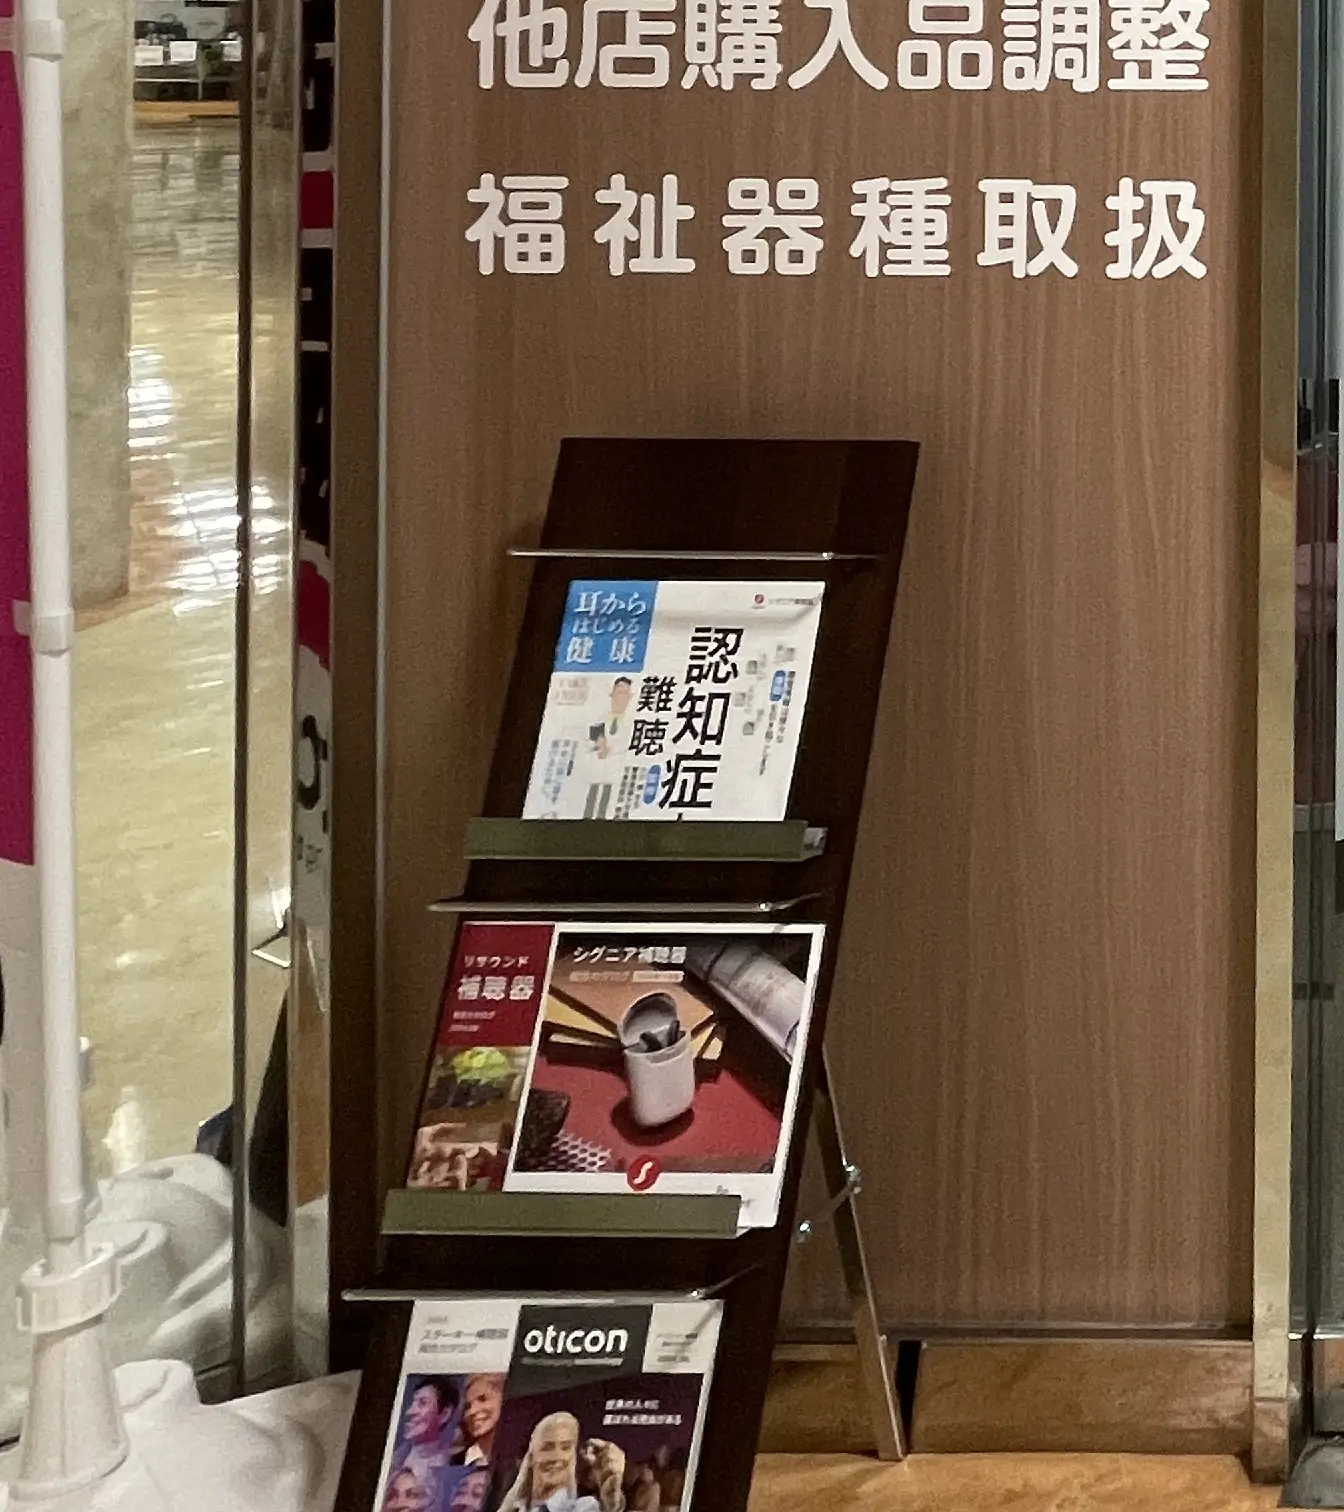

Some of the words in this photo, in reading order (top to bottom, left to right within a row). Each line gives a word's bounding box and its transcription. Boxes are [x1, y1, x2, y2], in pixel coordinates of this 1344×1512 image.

[465, 172, 1208, 281] 福祉器種取扱
[573, 590, 648, 616] 耳から
[565, 636, 638, 664] 健康
[628, 676, 678, 757] 難聴
[658, 626, 744, 820] 認知症
[524, 1326, 629, 1354] oticon
